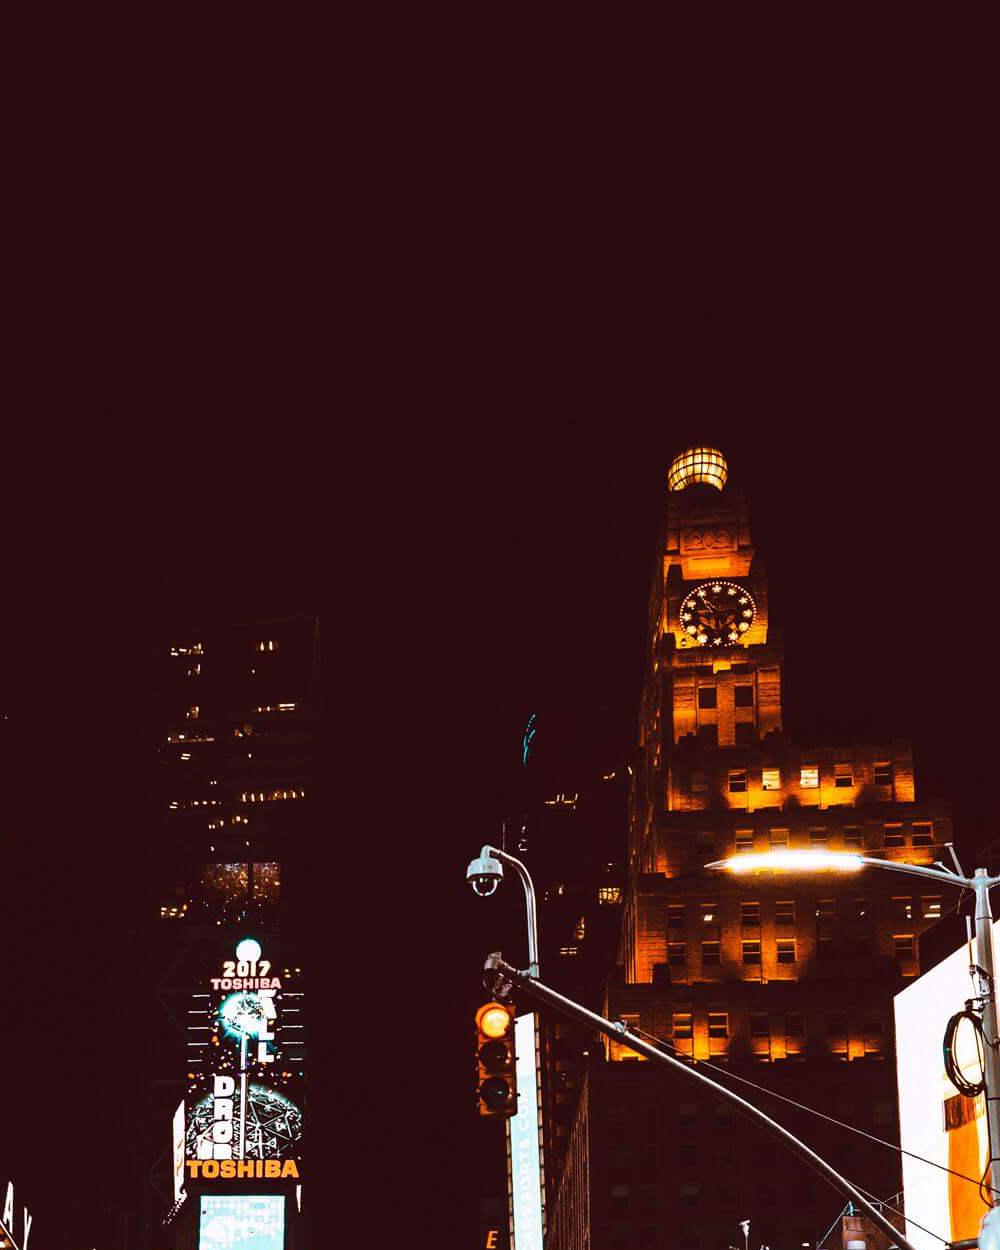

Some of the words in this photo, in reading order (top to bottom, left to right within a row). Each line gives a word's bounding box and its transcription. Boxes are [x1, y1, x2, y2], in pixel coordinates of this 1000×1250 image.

[222, 961, 271, 977] 2017
[210, 978, 282, 990] TOSHIBA
[187, 1159, 299, 1178] TOSHIBA
